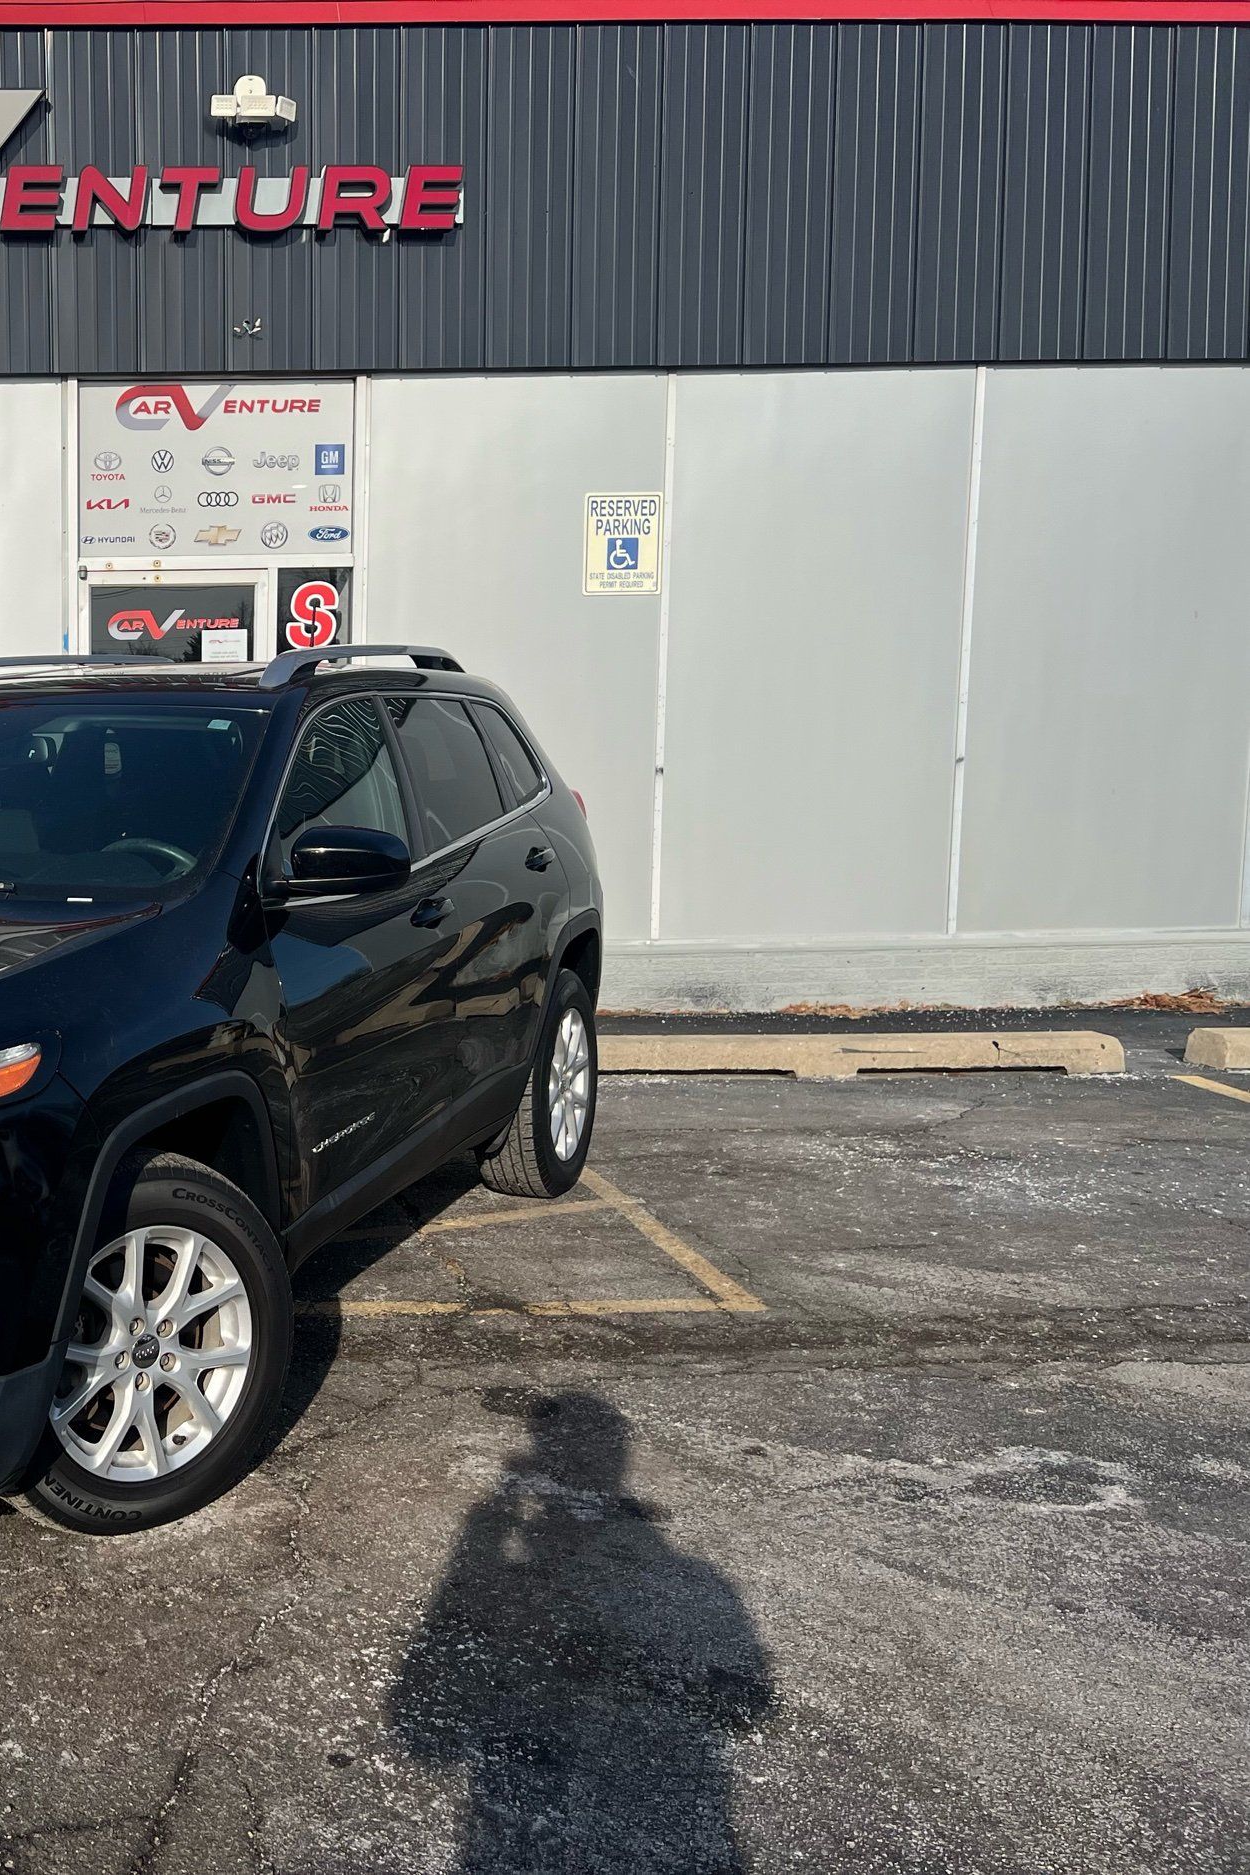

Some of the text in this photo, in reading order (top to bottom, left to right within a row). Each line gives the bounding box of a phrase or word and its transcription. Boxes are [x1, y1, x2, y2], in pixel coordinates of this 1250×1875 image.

[252, 451, 300, 471] Jeep
[321, 451, 338, 465] GM
[90, 473, 126, 481] TOYOTA
[251, 493, 296, 504] GMC
[140, 506, 187, 514] Mercedes-Benz
[590, 499, 657, 517] RESERVED
[596, 518, 651, 536] PARKING
[316, 528, 342, 539] Ford
[632, 572, 655, 580] PARKING
[286, 581, 339, 649] S
